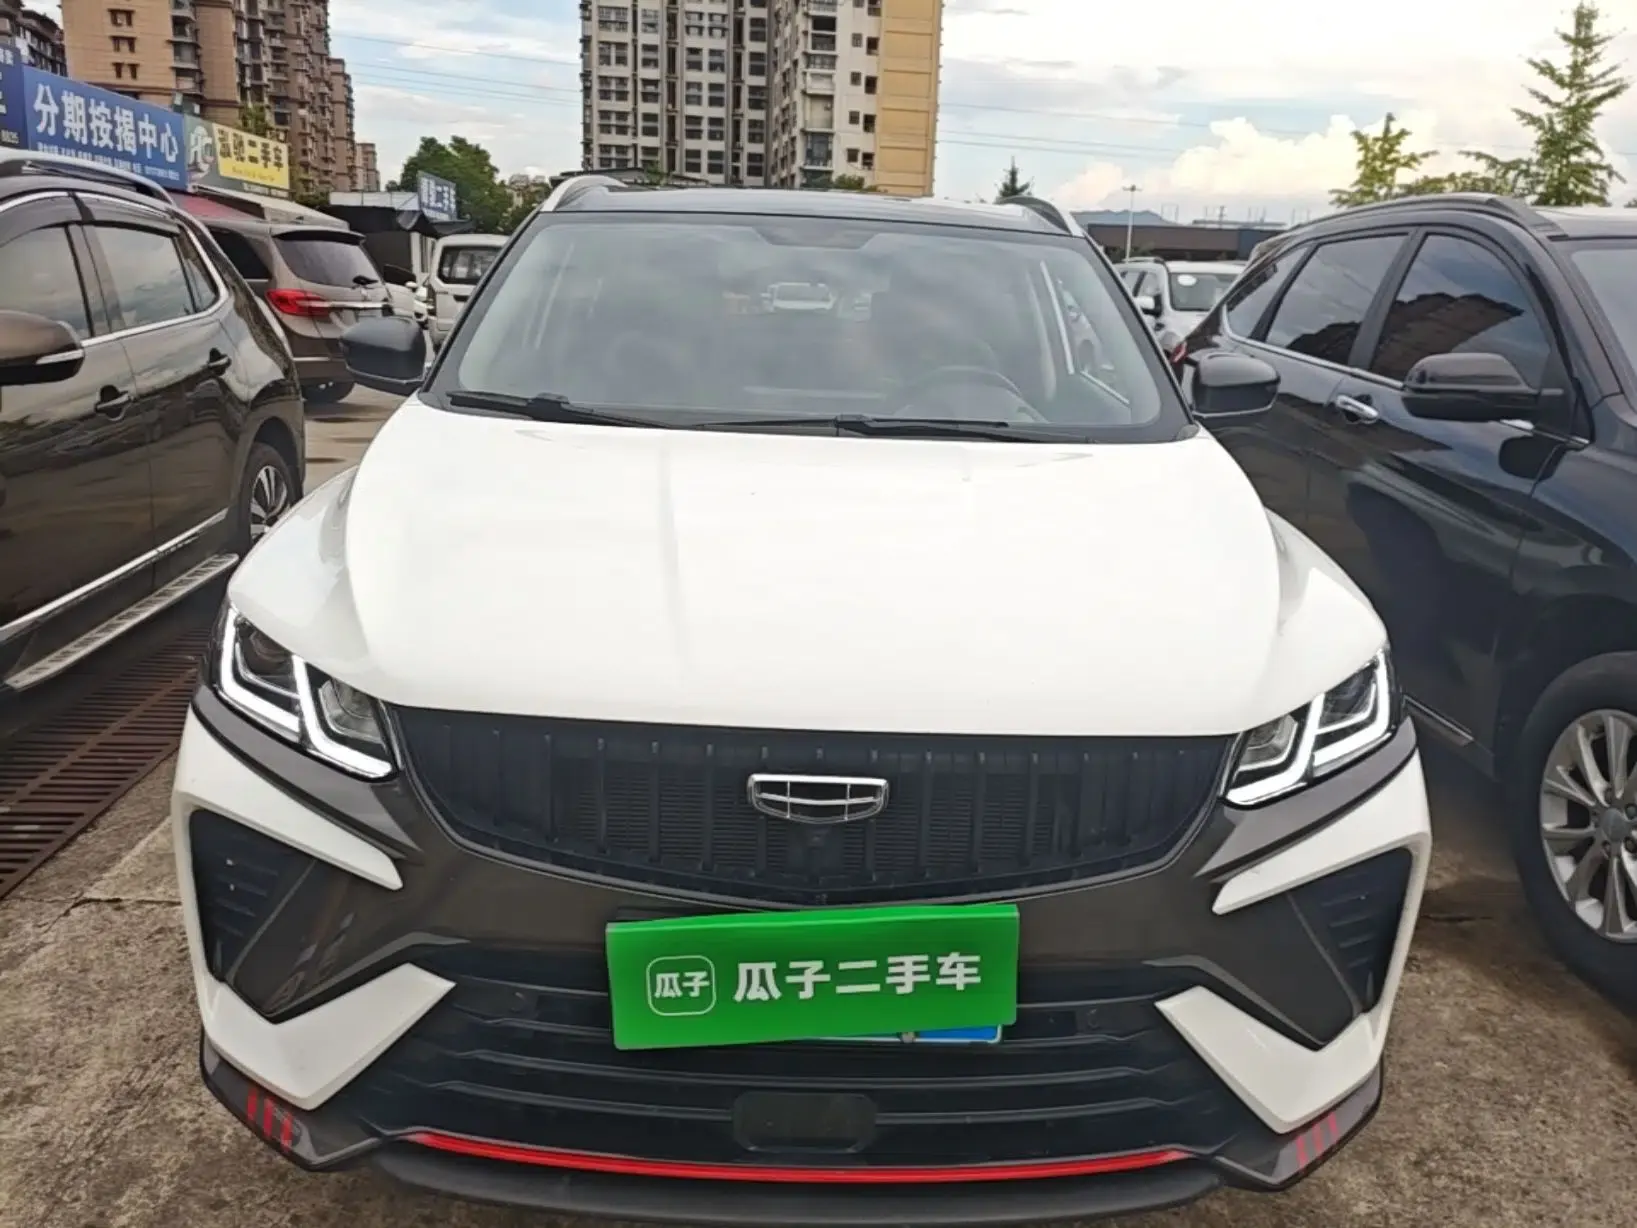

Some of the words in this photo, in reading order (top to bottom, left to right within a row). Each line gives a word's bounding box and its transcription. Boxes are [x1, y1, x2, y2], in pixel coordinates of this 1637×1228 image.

[33, 83, 179, 163] 分期按揭中心
[653, 970, 710, 999] 瓜子
[733, 951, 982, 1002] 瓜子二手车
